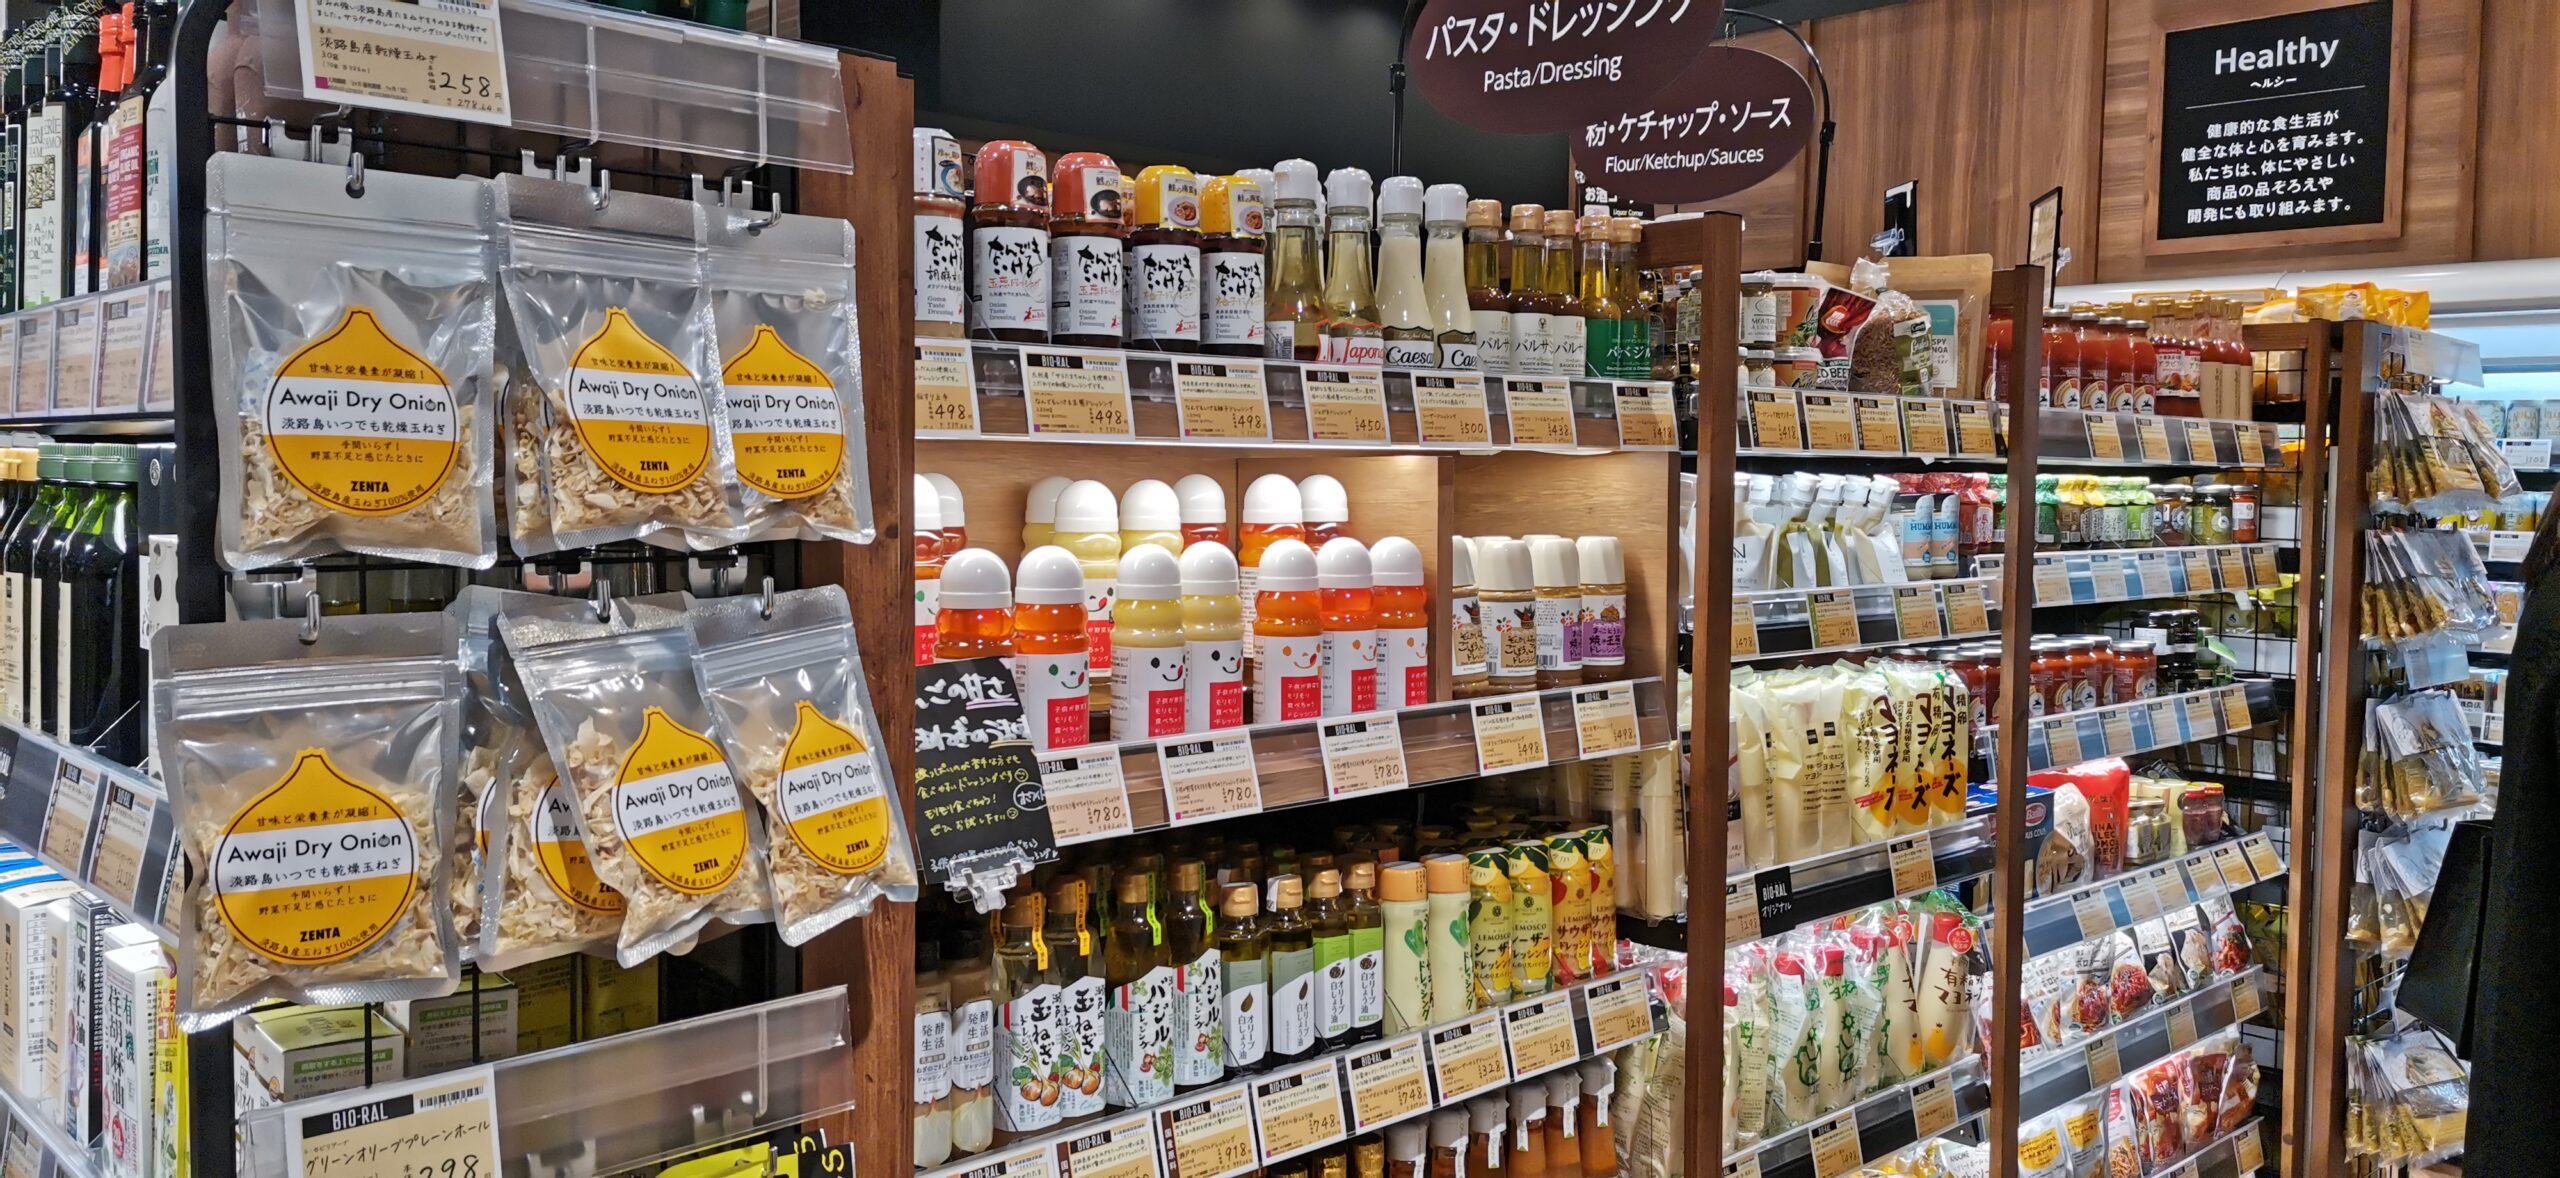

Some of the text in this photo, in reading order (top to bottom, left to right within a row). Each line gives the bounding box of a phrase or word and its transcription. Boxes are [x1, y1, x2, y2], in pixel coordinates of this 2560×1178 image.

[2214, 36, 2339, 76] Healthy
[1483, 53, 1623, 93] Pasta/Dressing
[438, 71, 491, 98] 258
[2250, 76, 2297, 89] ヘルシー
[2206, 109, 2340, 139] 健康的な食生活が
[2180, 129, 2364, 163] 健全な体と心を育みます。
[1604, 146, 1764, 174] Flour/Ketchup/Sauces
[2187, 152, 2356, 183] 私たちは、体にやさしい
[2206, 176, 2334, 202] 商品の品ぞろえや
[2186, 196, 2351, 224] 開発にも取り組みます。
[1041, 355, 1070, 368] BIO-RAL
[1190, 364, 1215, 376] BIO-RAL
[308, 363, 425, 380] 甘味と栄養素が凝縮！
[1317, 372, 1339, 382] BIO-RAL
[578, 377, 697, 400] Awaji Dry Onion
[1425, 378, 1445, 387] BIO-RAL
[1516, 382, 1536, 391] BIO-RAL
[279, 388, 446, 413] Awaji Dry Onion
[765, 395, 836, 412] Dry Onion
[583, 403, 700, 421] 淡路島いつでも乾燥玉ねぎ
[935, 404, 966, 420] 498
[1095, 410, 1122, 425] 498
[281, 417, 446, 435] 淡路島いつでも乾燥玉ねぎ
[1238, 415, 1262, 428] 498
[1359, 419, 1382, 432] 450
[1464, 422, 1484, 434] 500
[1551, 425, 1570, 436] 438
[1782, 427, 1798, 440] 418
[310, 451, 423, 463] 野菜不足と感じたときに
[639, 460, 670, 472] ZENTA
[776, 468, 806, 479] ZENTA
[350, 480, 390, 493] ZENTA
[1335, 724, 1358, 735] BIO-RAL
[1617, 728, 1633, 740] 498
[1178, 744, 1203, 756] BIO-RAL
[1522, 741, 1540, 754] 498
[1378, 764, 1399, 778] 780
[788, 768, 845, 795] Awaji Dry
[625, 773, 732, 811] Awaji Dry Onion
[1227, 787, 1252, 802] 780
[256, 806, 379, 827] 甘味と栄養素が凝縮！
[632, 797, 736, 831] 淡路島いつでも乾燥玉ねぎ
[1093, 805, 1121, 821] 780
[227, 832, 401, 863] Awaji Dry Onion
[845, 839, 870, 855] ZENTA
[229, 858, 401, 887] 淡路島いつでも乾燥玉ねぎ
[693, 858, 720, 874] ZENTA
[1762, 880, 1788, 901] BIO-RAL
[258, 893, 377, 915] 野菜不足と感じたときに
[1761, 902, 1793, 918] オリジナル
[299, 926, 340, 943] ZENTA
[75, 943, 87, 1047] 亜麻仁油
[1201, 959, 1220, 1027] バジル
[1360, 972, 1369, 1014] 白しょう油
[1368, 972, 1376, 1005] オリーブ
[1597, 984, 1614, 996] BIO-RAL
[1147, 976, 1170, 1047] バジル
[1194, 985, 1204, 1030] ドレッシング
[1517, 1006, 1535, 1019] BIO-RAL
[968, 1010, 989, 1025] 発酵
[1074, 988, 1098, 1055] 玉ねぎ
[1630, 1016, 1647, 1027] 298
[122, 996, 136, 1065] 有機
[921, 1022, 944, 1037] 発酵
[968, 1024, 989, 1040] 生活
[1030, 996, 1055, 1065] 玉ねぎ
[1138, 1004, 1150, 1049] ドレッシング
[1247, 1015, 1255, 1050] オリーブ
[1443, 1028, 1463, 1042] BIO-RAL
[921, 1036, 944, 1052] 生活
[1238, 1015, 1247, 1059] 白しょう油
[1553, 1039, 1571, 1052] 298
[1361, 1053, 1382, 1068] BIO-RAL
[1482, 1060, 1501, 1077] 328
[1269, 1079, 1292, 1094] BIO-RAL
[1403, 1087, 1423, 1104] 748
[332, 1103, 389, 1131] BIO-RAL
[1179, 1103, 1206, 1121] BIO-RAL
[1313, 1114, 1336, 1132] 748
[306, 1121, 491, 1176] グリーンオリーブプレーンホール
[1077, 1133, 1106, 1151] BIO-RAL
[1165, 1129, 1176, 1169] 国産原料
[1225, 1143, 1246, 1161] 918
